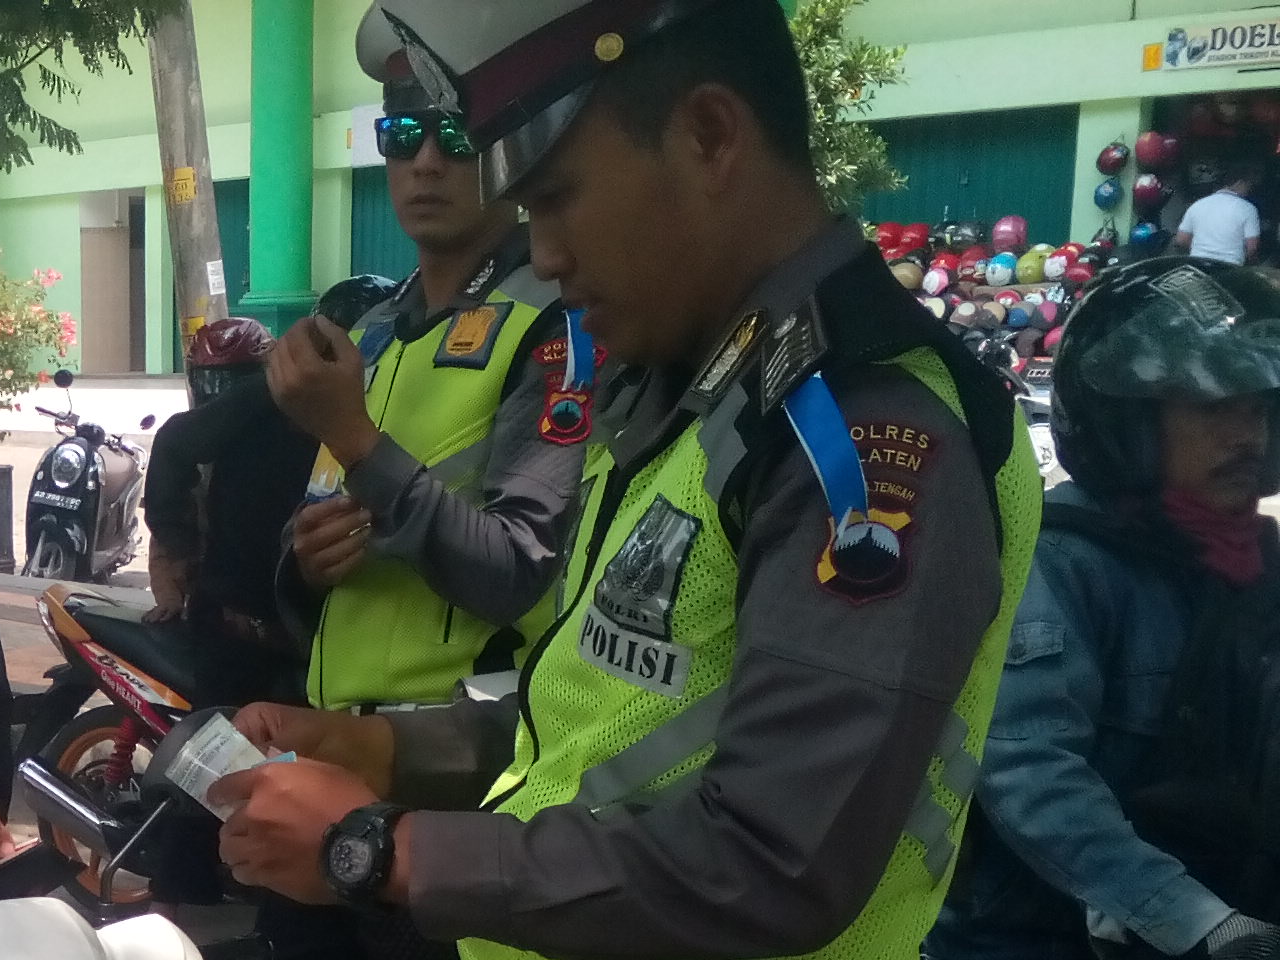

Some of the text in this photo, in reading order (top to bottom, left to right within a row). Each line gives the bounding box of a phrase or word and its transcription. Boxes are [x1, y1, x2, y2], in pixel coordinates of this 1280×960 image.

[849, 424, 930, 449] OLRES
[861, 448, 922, 472] ATEN
[580, 614, 678, 686] POLISI
